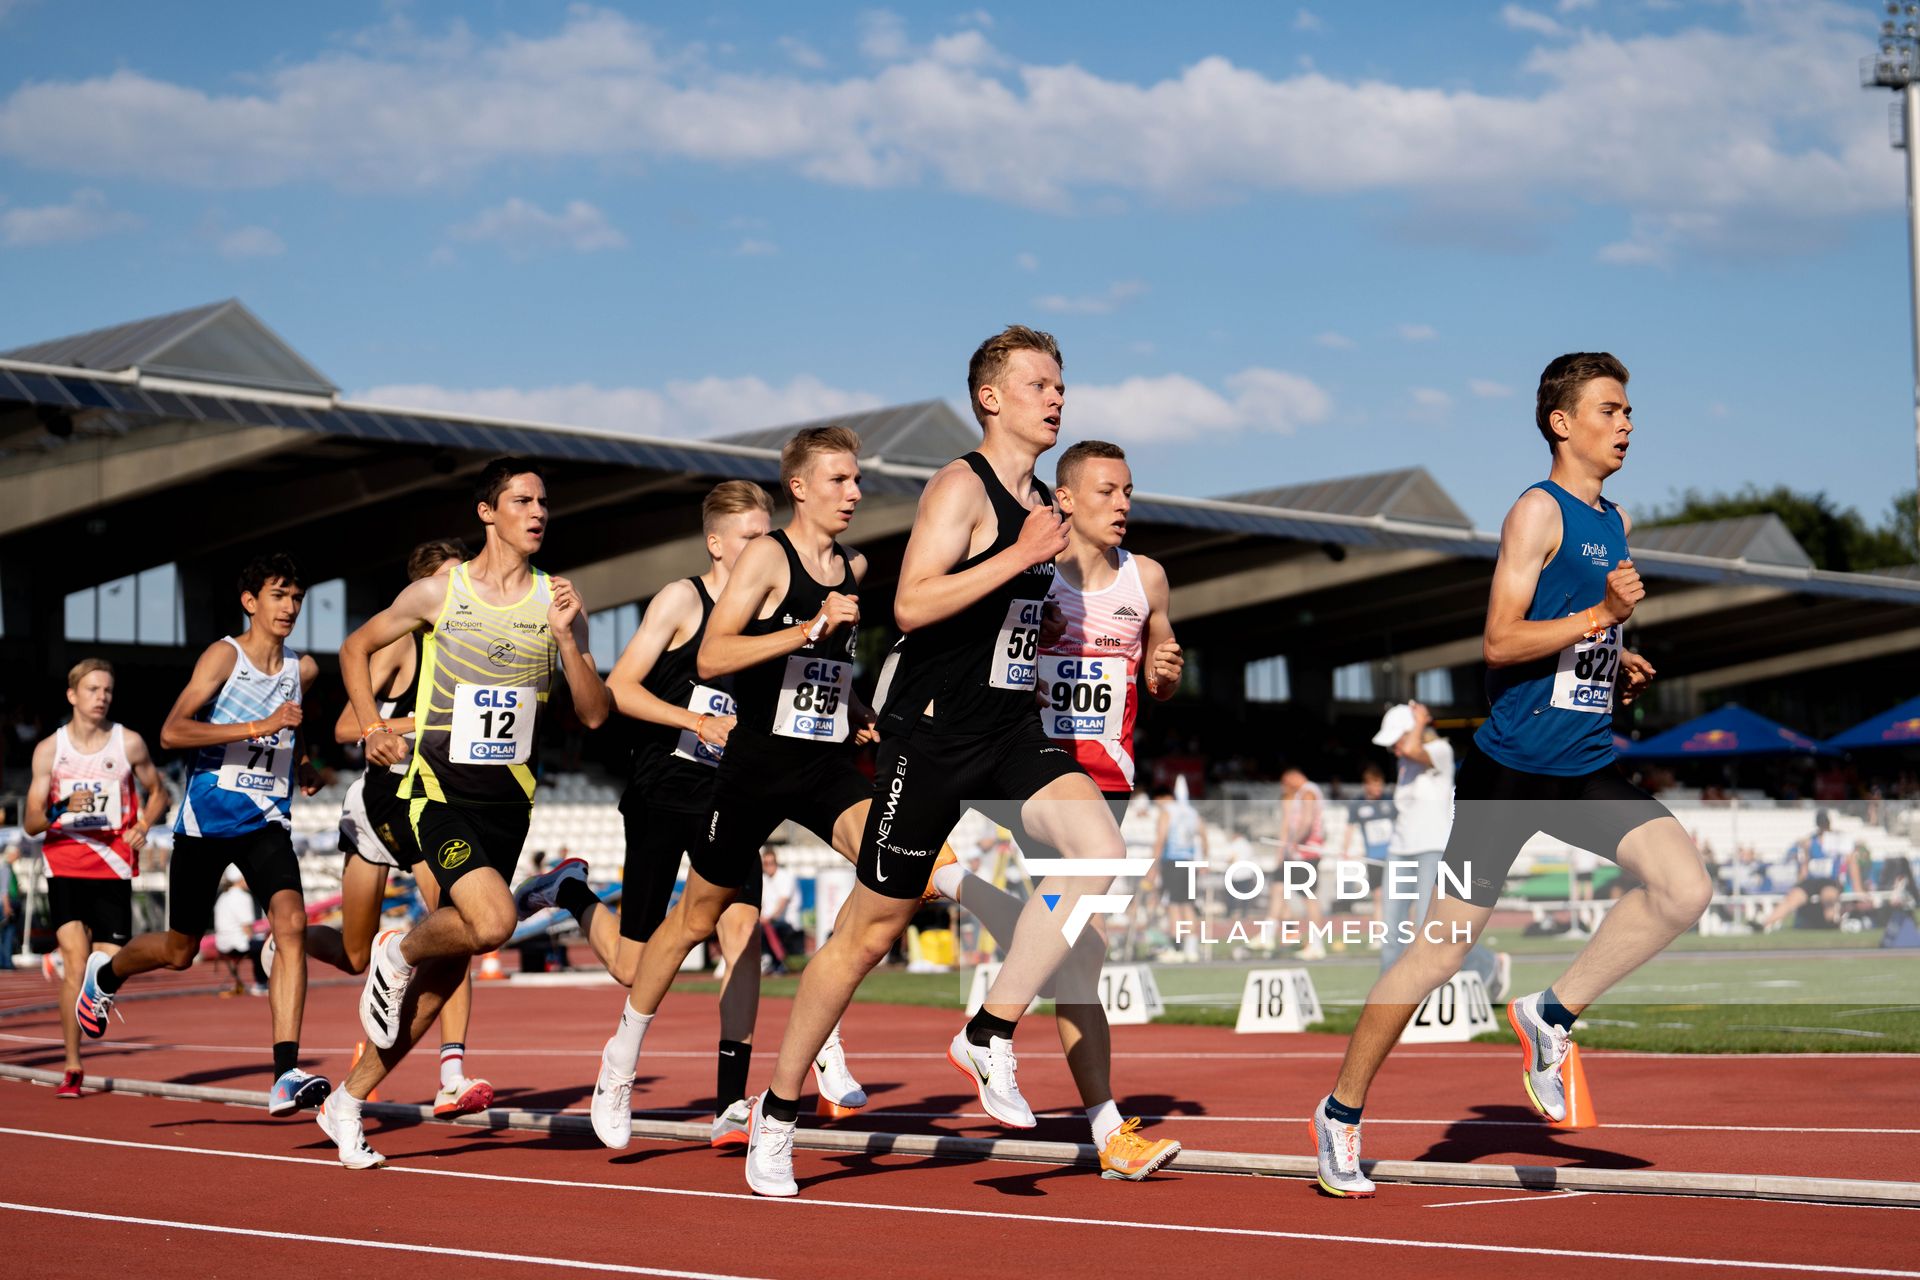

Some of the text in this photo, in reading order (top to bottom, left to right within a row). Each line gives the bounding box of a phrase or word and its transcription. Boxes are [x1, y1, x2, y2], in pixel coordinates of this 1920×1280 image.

[1095, 635, 1121, 647] eins
[1575, 649, 1619, 683] 822
[793, 682, 842, 716] 855
[1051, 681, 1112, 713] 906
[479, 711, 516, 739] 12
[1076, 719, 1104, 729] PLAN
[247, 745, 275, 773] 71
[490, 745, 515, 754] PLAN
[253, 776, 275, 787] PLAN
[1103, 973, 1131, 1011] 16
[1253, 977, 1283, 1018] 18
